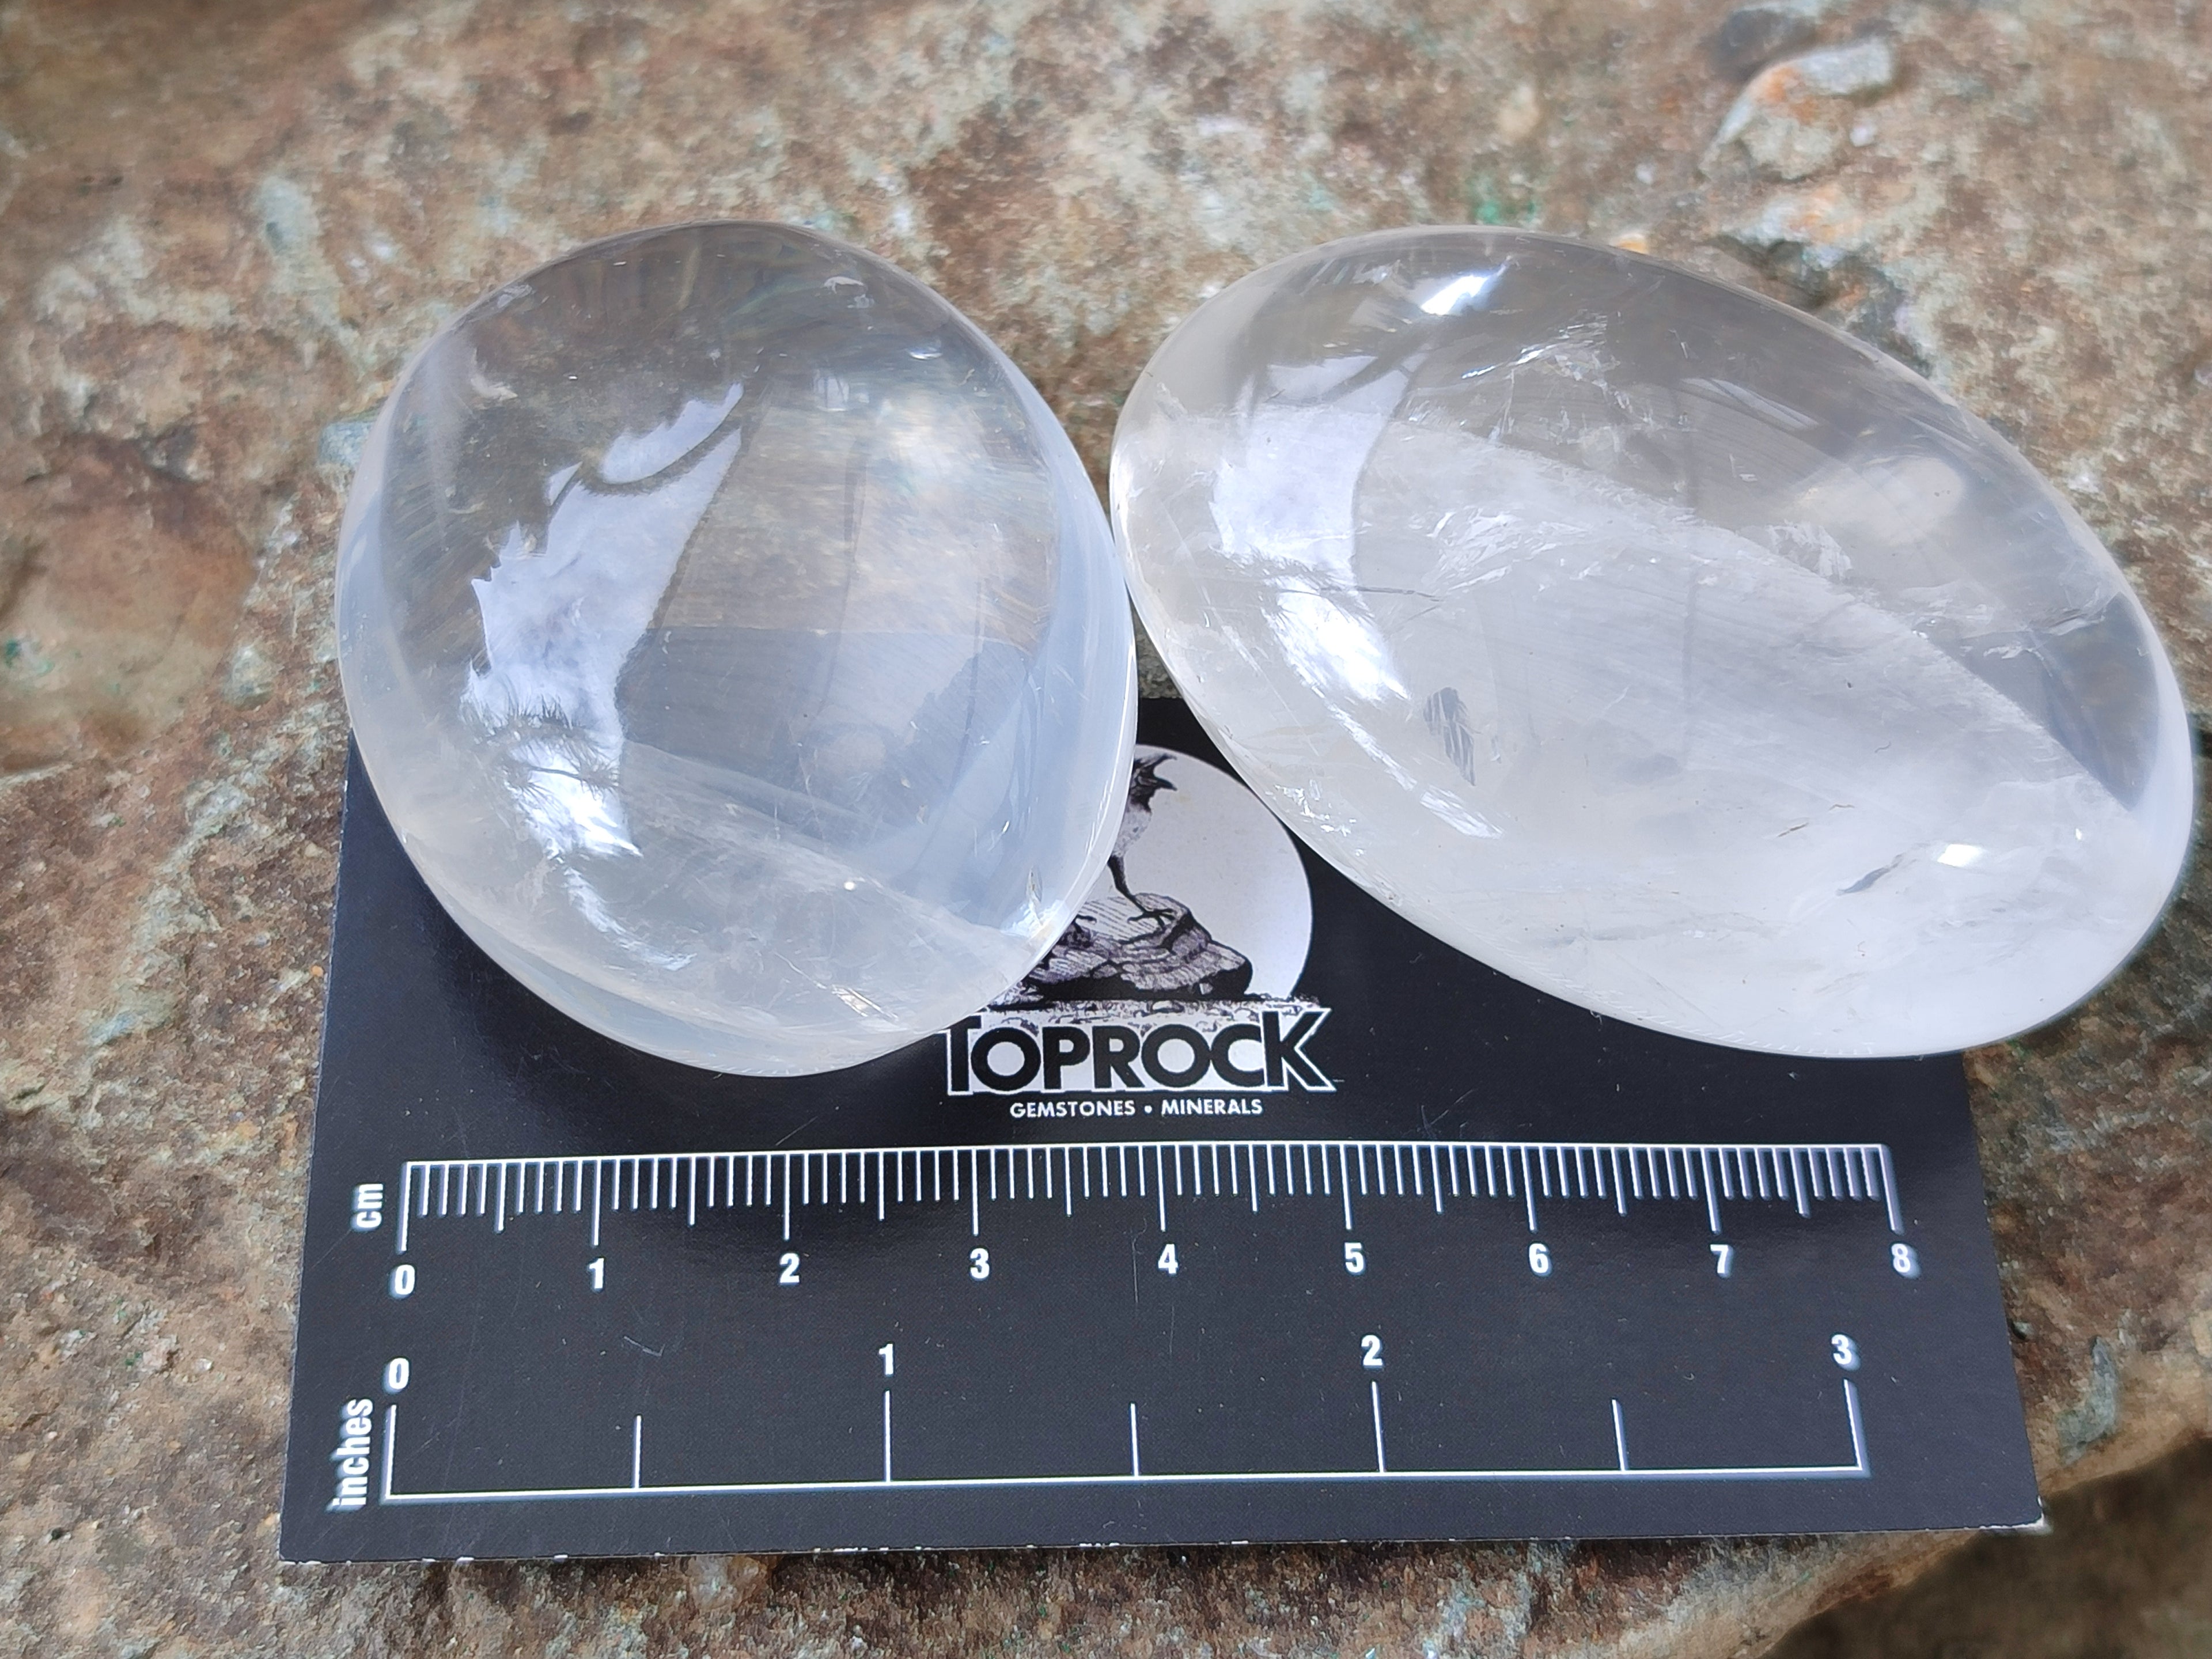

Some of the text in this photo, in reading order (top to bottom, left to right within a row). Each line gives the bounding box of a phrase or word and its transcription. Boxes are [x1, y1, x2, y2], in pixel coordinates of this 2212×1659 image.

[942, 1007, 1336, 1096] TOPROCK
[1010, 1098, 1263, 1118] GEMSTONES MINERALS
[352, 1183, 384, 1230] cm
[392, 1242, 1917, 1298] 0 1 2 3 4 5 6 7 8
[385, 1334, 1858, 1392] 0 1 2 3
[327, 1399, 373, 1510] inches
